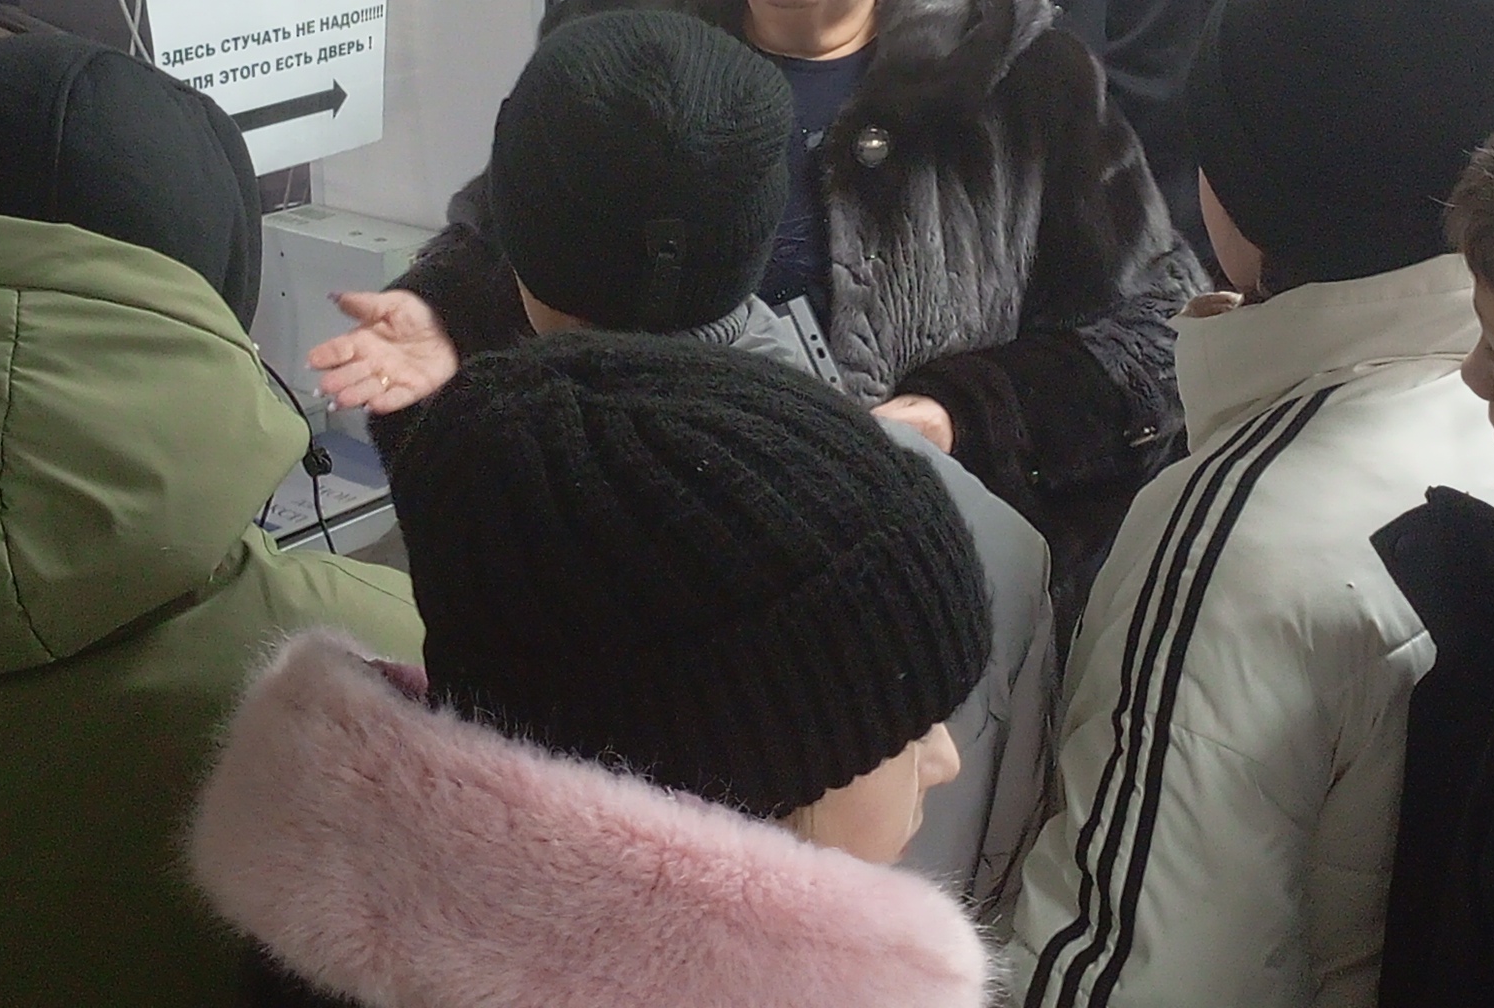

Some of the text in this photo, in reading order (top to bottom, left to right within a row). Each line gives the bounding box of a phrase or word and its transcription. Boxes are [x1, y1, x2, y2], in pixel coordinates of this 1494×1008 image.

[161, 42, 216, 68] ЗДЕСЬ
[220, 26, 292, 54] СТУЧАТЬ
[295, 19, 316, 38] НЕ
[219, 60, 271, 85] ЭТОГО
[276, 51, 313, 72] ЕСТЬ
[317, 38, 365, 65] ДВЕРЬ
